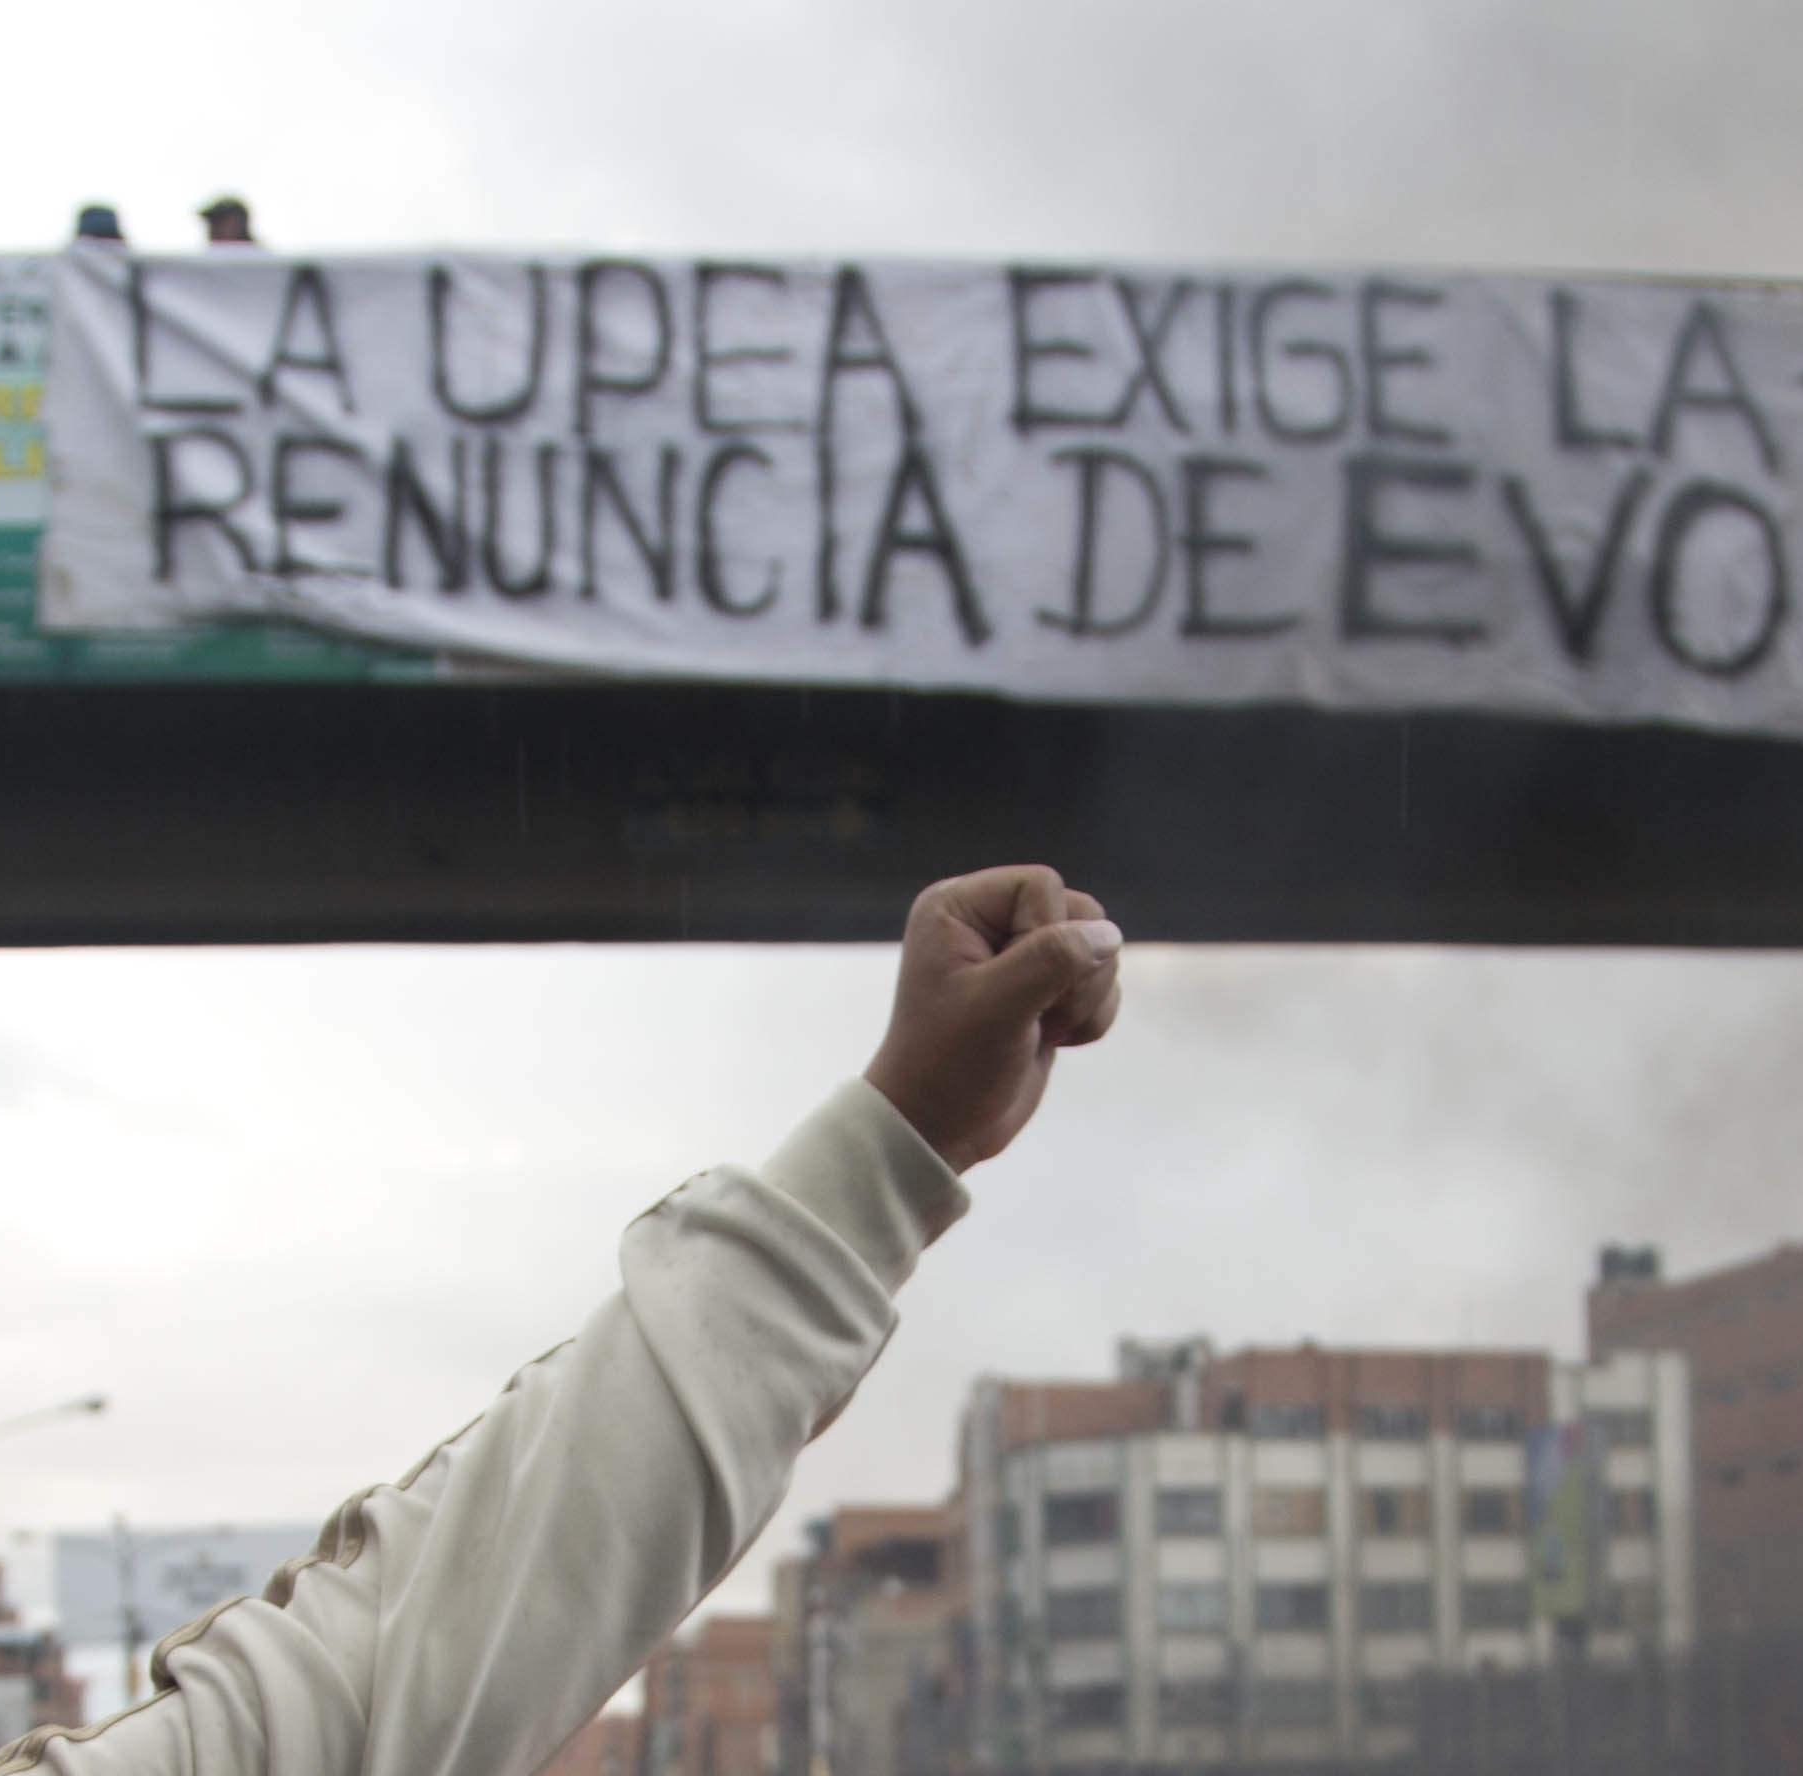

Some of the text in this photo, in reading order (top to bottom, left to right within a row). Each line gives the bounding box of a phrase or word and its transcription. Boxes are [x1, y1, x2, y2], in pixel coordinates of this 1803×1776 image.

[129, 262, 357, 414] LA
[427, 260, 923, 436] UPEA
[1005, 268, 1458, 446] EXIGE
[1550, 290, 1783, 475] LA
[152, 427, 993, 648] RENUNCIA
[1035, 446, 1304, 640] DE
[1337, 454, 1790, 680] EVO
